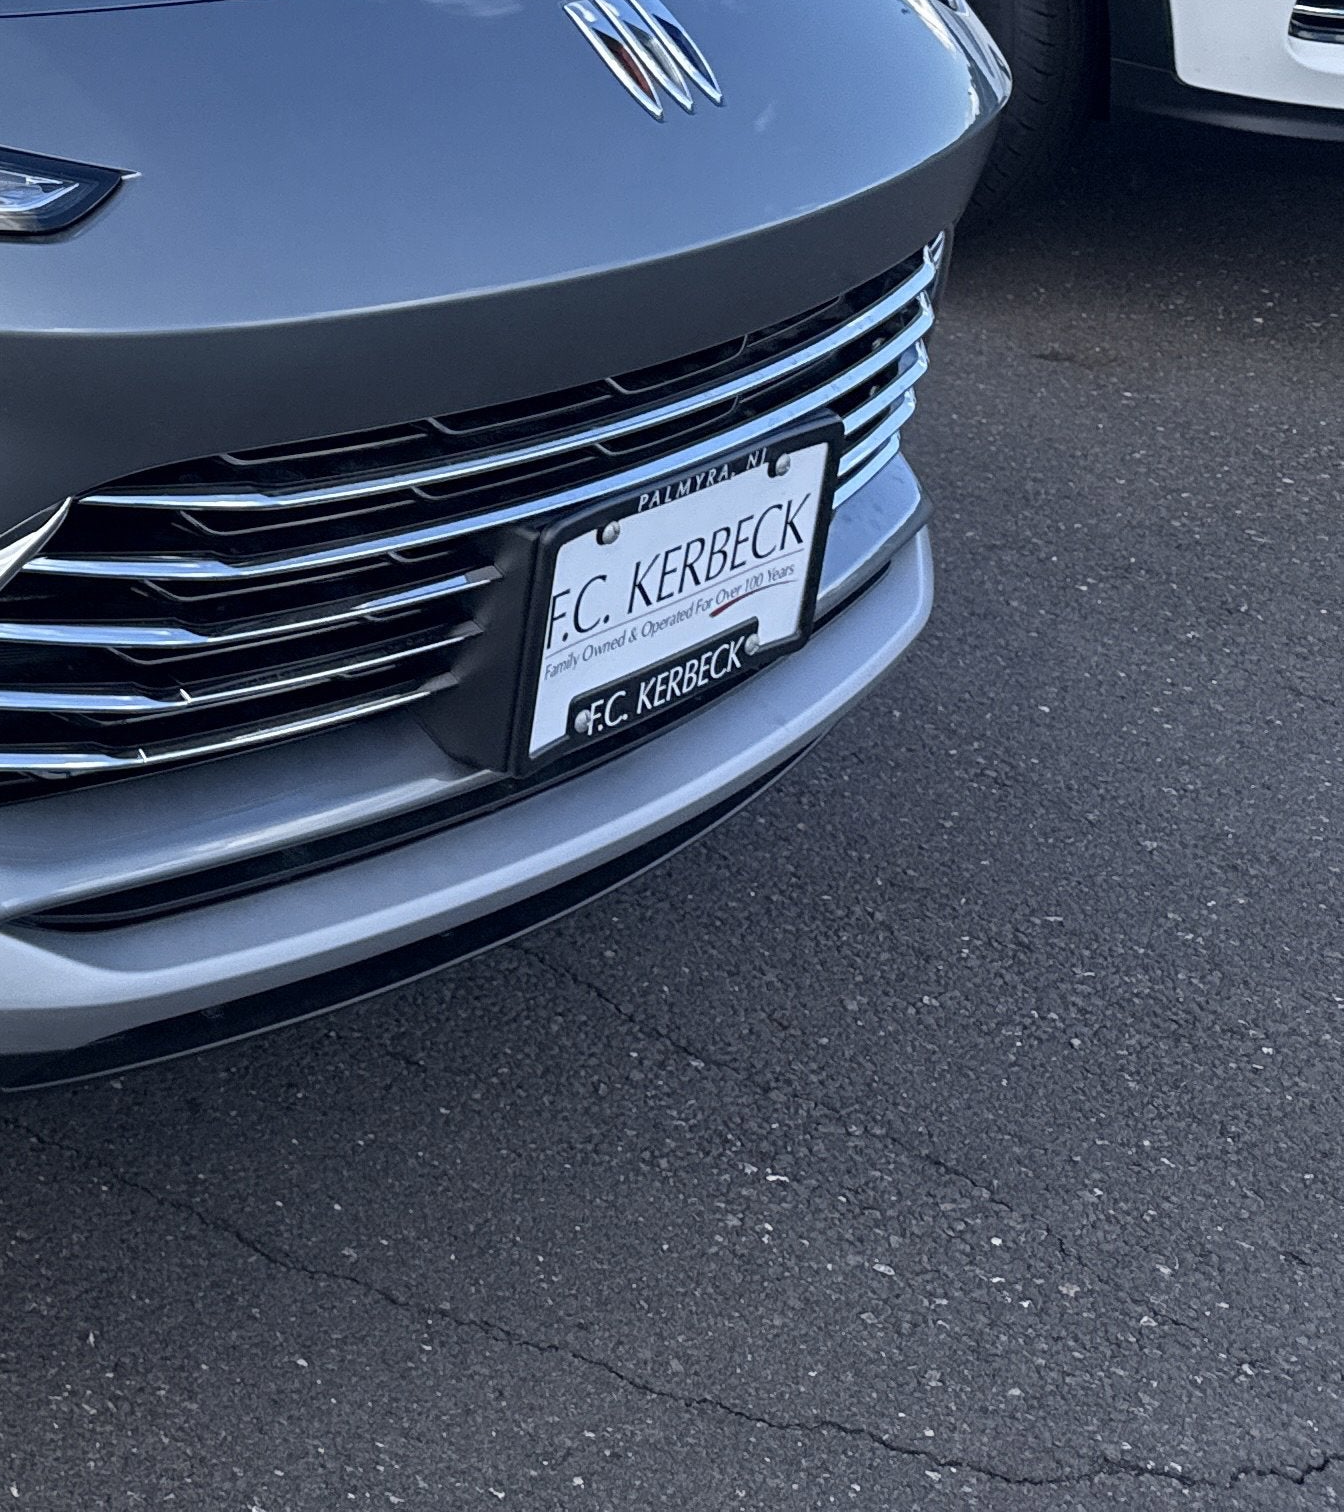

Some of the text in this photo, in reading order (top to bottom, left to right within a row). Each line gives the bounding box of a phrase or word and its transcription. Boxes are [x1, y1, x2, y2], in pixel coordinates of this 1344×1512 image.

[544, 564, 794, 680] Family Owned & Operated For Over 100 Years
[546, 492, 811, 649] F.C. KERBECK
[587, 635, 745, 736] F.C. KERBECK
